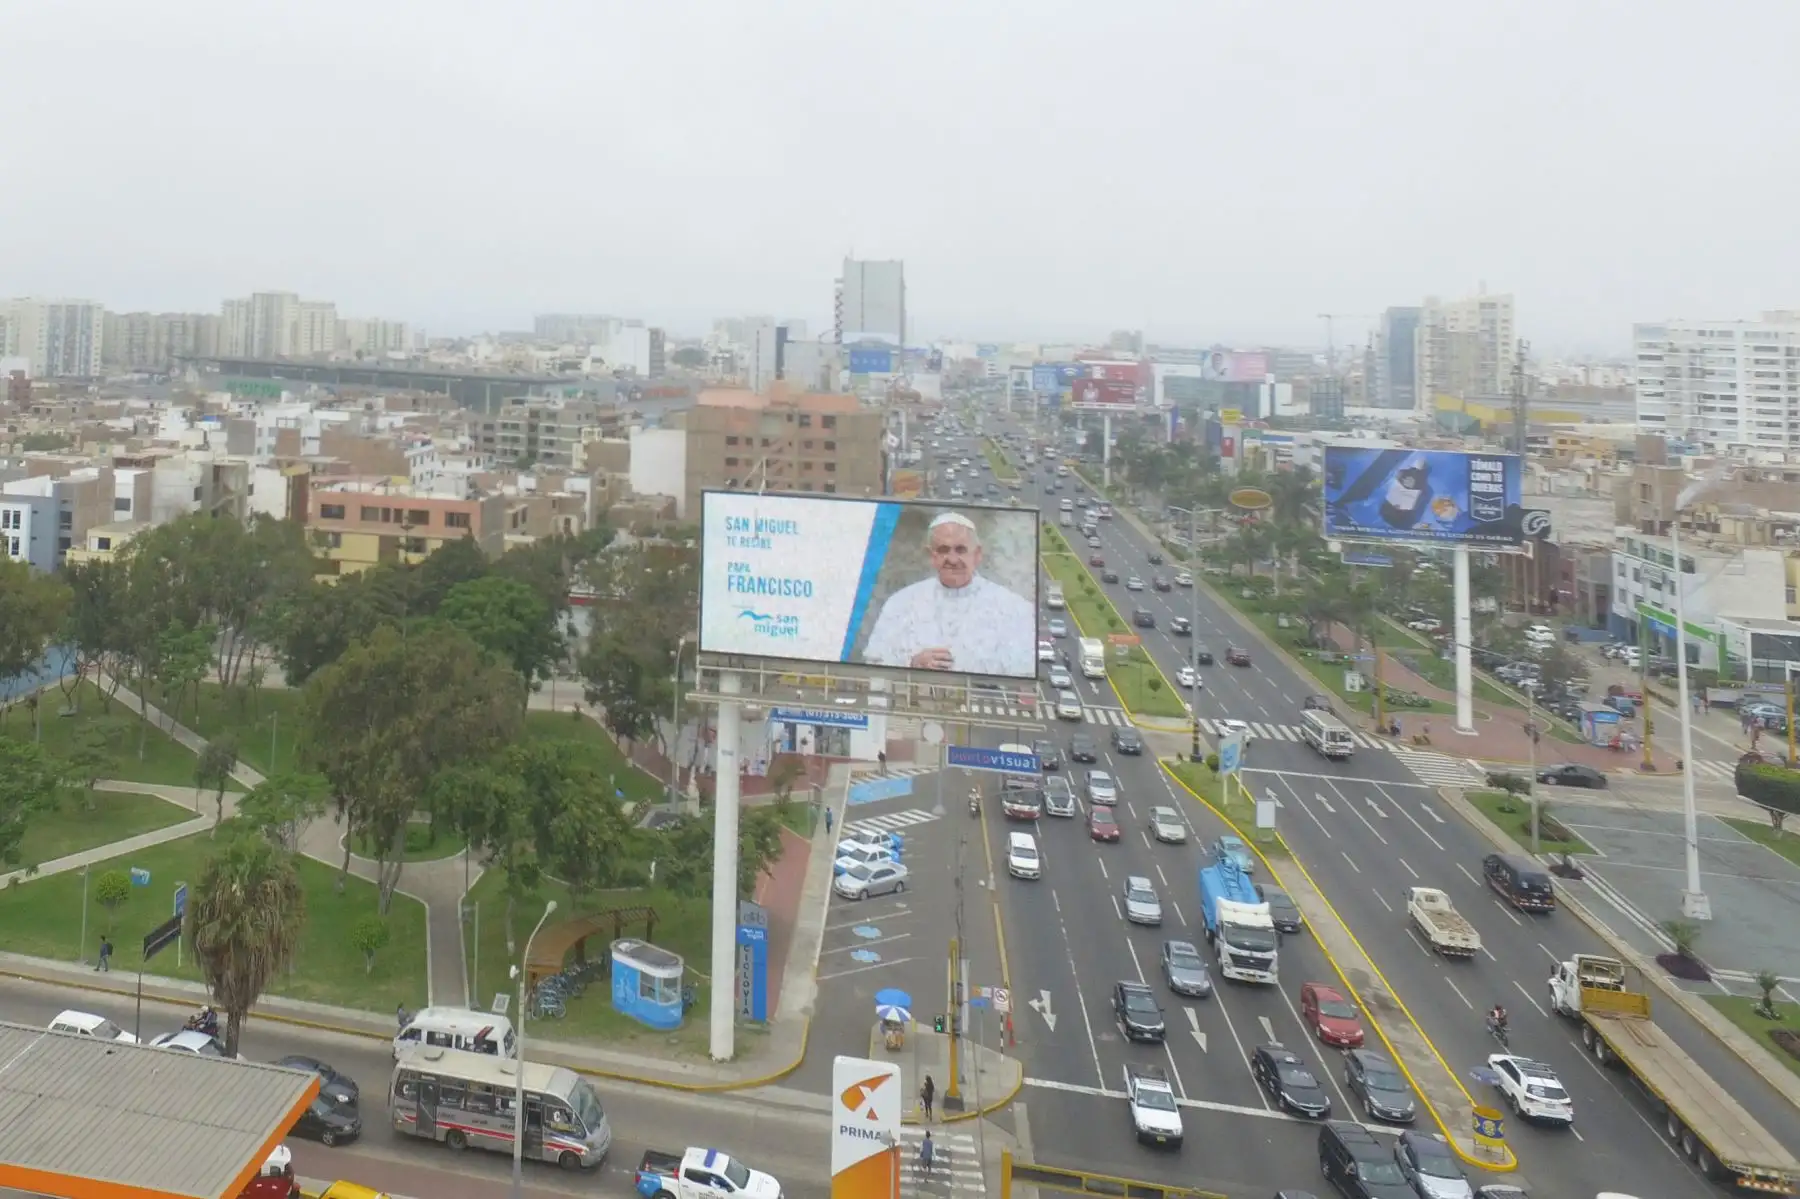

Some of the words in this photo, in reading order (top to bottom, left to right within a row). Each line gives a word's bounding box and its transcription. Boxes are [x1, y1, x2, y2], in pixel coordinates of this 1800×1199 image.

[725, 516, 749, 532] SAN
[755, 517, 799, 535] MIGUEL
[727, 575, 812, 597] FRANCISCO
[754, 621, 798, 637] miguel
[840, 1125, 882, 1141] PRIMA
